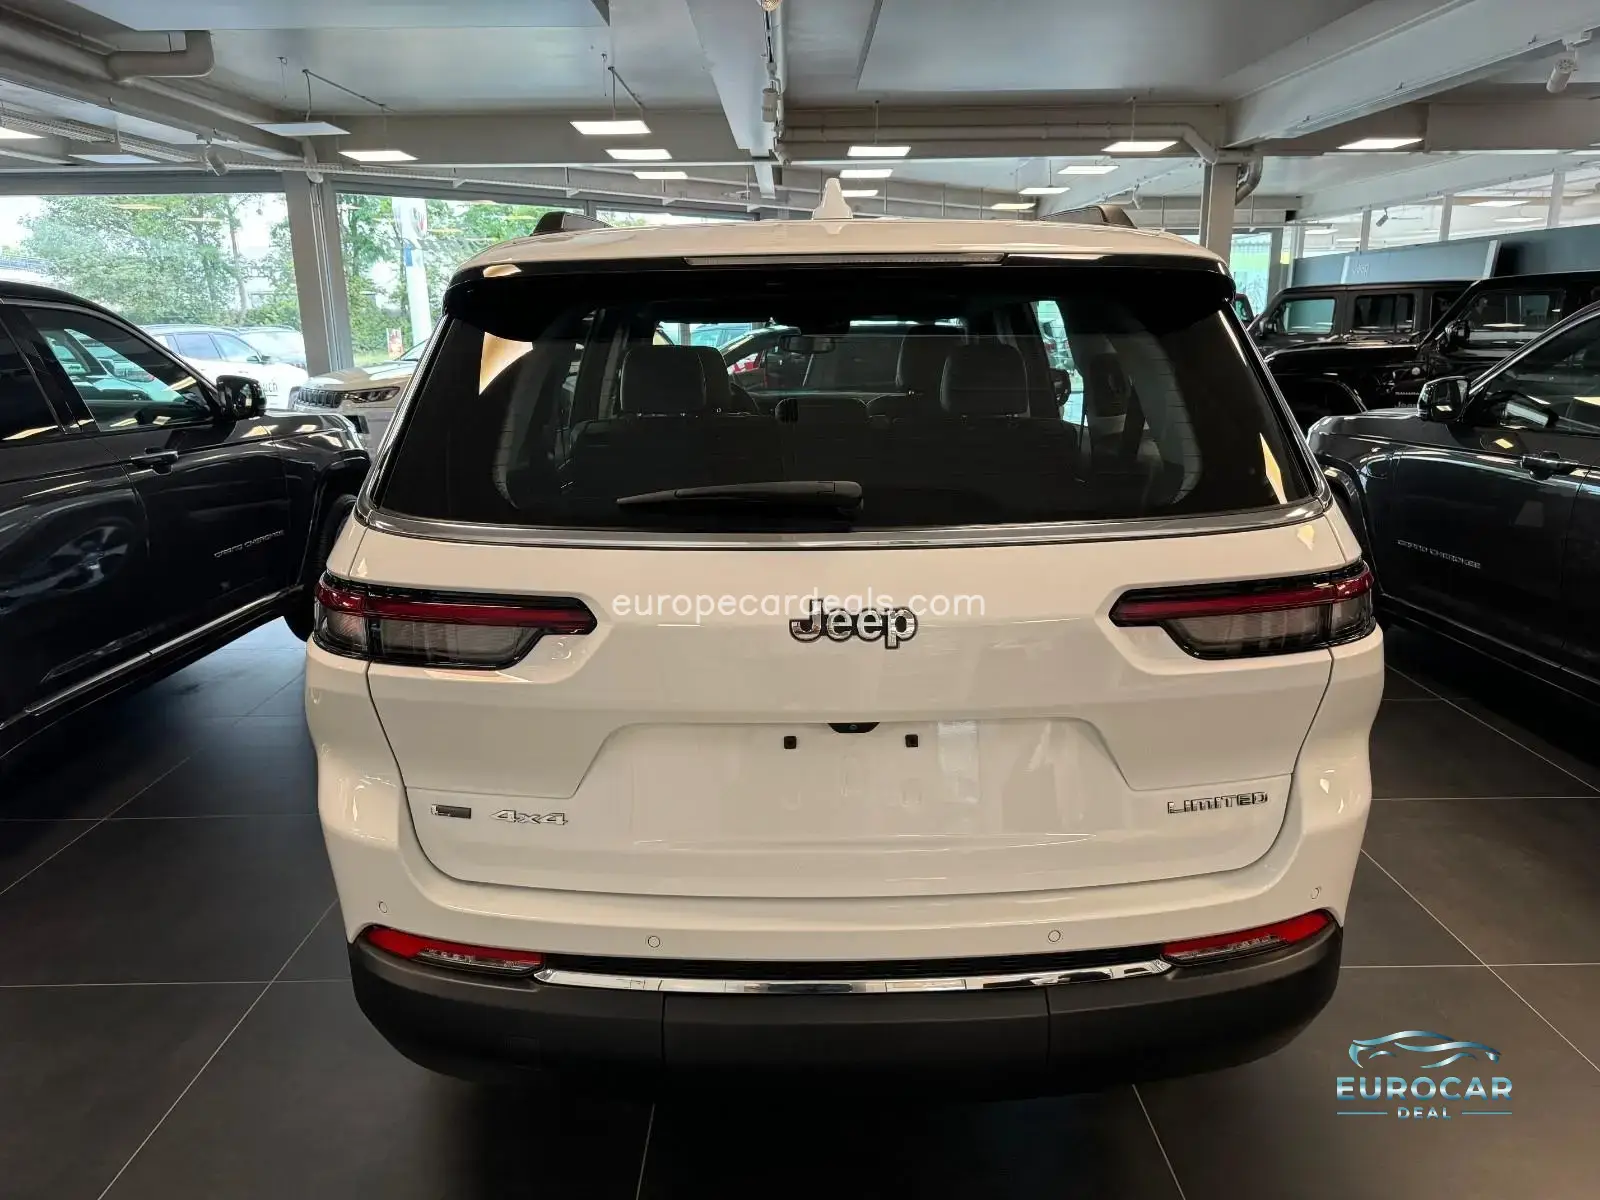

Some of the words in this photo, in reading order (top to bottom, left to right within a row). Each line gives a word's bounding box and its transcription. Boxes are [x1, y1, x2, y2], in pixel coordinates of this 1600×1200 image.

[789, 598, 918, 649] Jeep
[1167, 791, 1268, 814] LIMITED
[490, 809, 567, 825] 4x4
